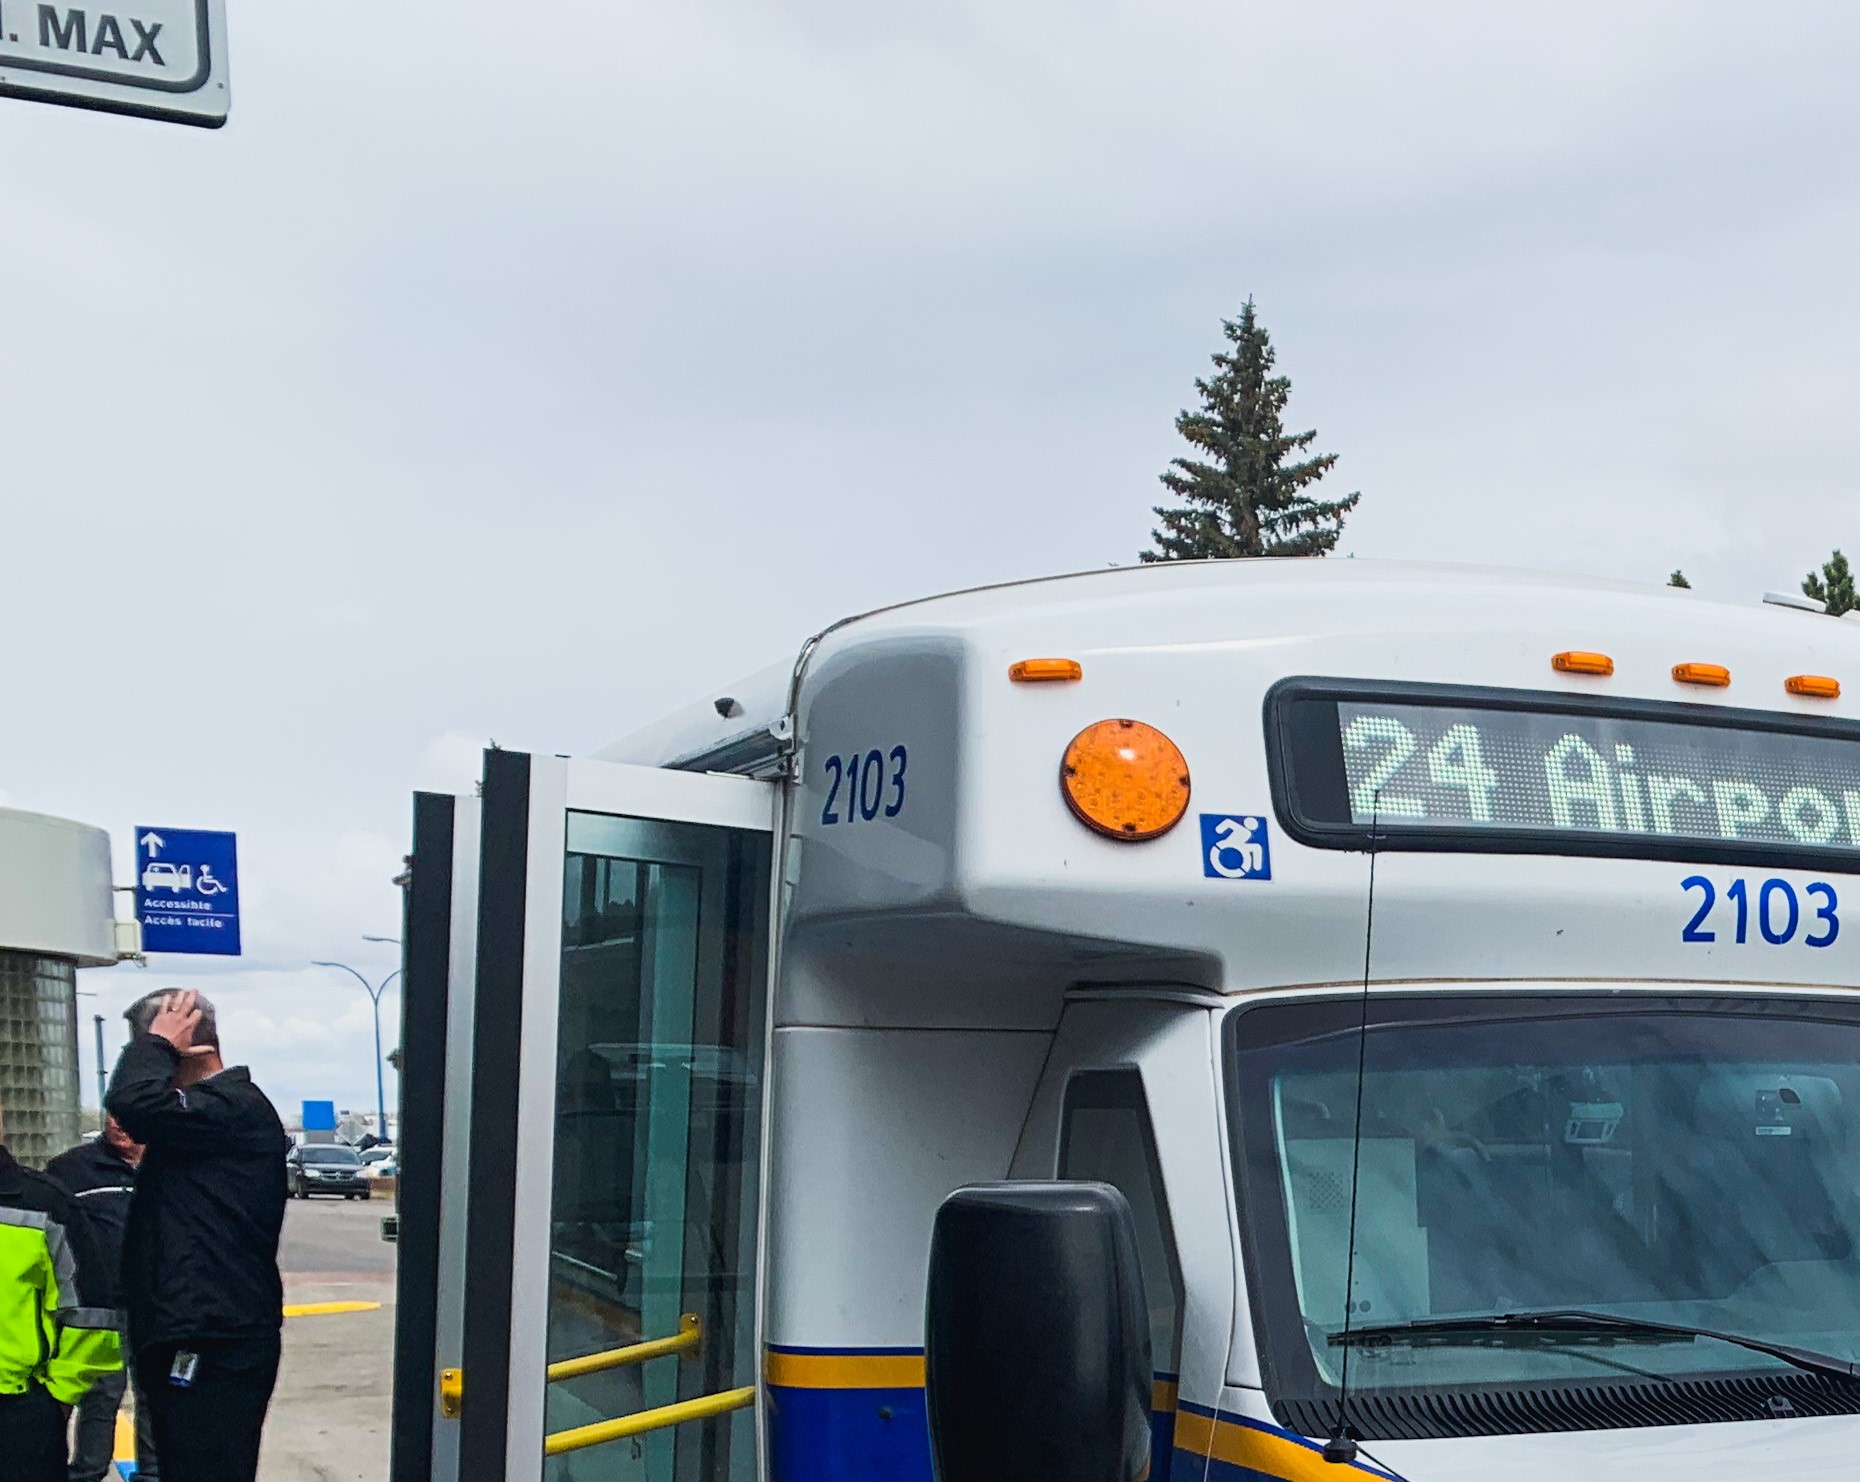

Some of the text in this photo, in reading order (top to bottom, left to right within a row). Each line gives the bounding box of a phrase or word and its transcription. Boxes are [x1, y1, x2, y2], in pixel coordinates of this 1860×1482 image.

[37, 3, 166, 67] MAX
[822, 744, 907, 825] 2103
[1345, 716, 1497, 822] 24
[144, 898, 213, 911] Accessible
[1680, 875, 1840, 948] 2103
